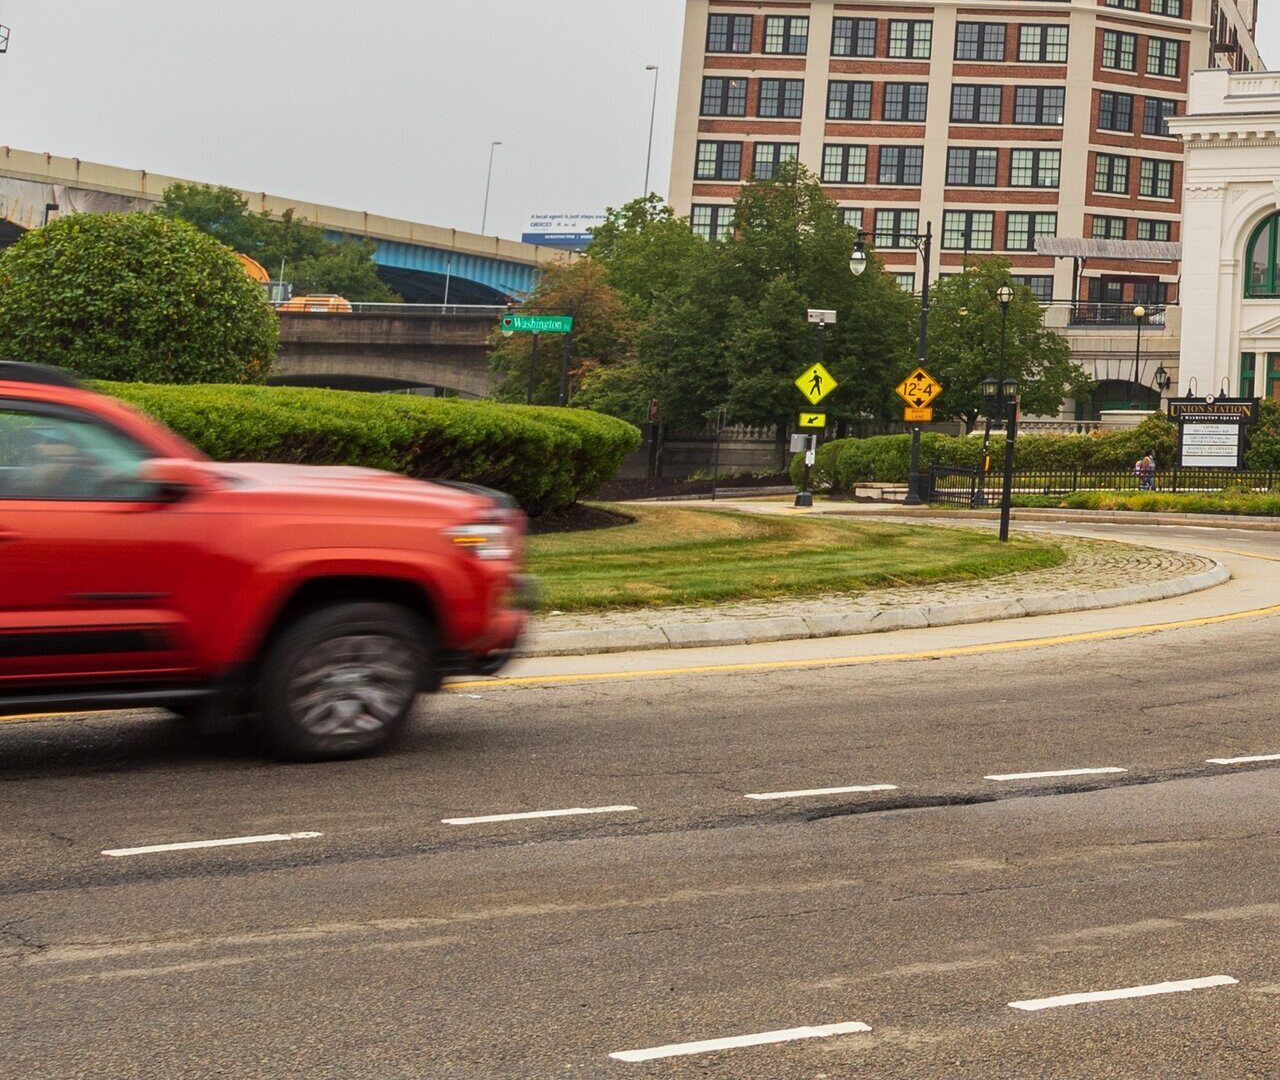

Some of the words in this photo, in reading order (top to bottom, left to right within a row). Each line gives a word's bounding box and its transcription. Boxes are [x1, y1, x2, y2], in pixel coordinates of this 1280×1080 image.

[514, 317, 562, 331] Washington
[1170, 405, 1205, 417] UNION
[1207, 405, 1252, 417] STATION
